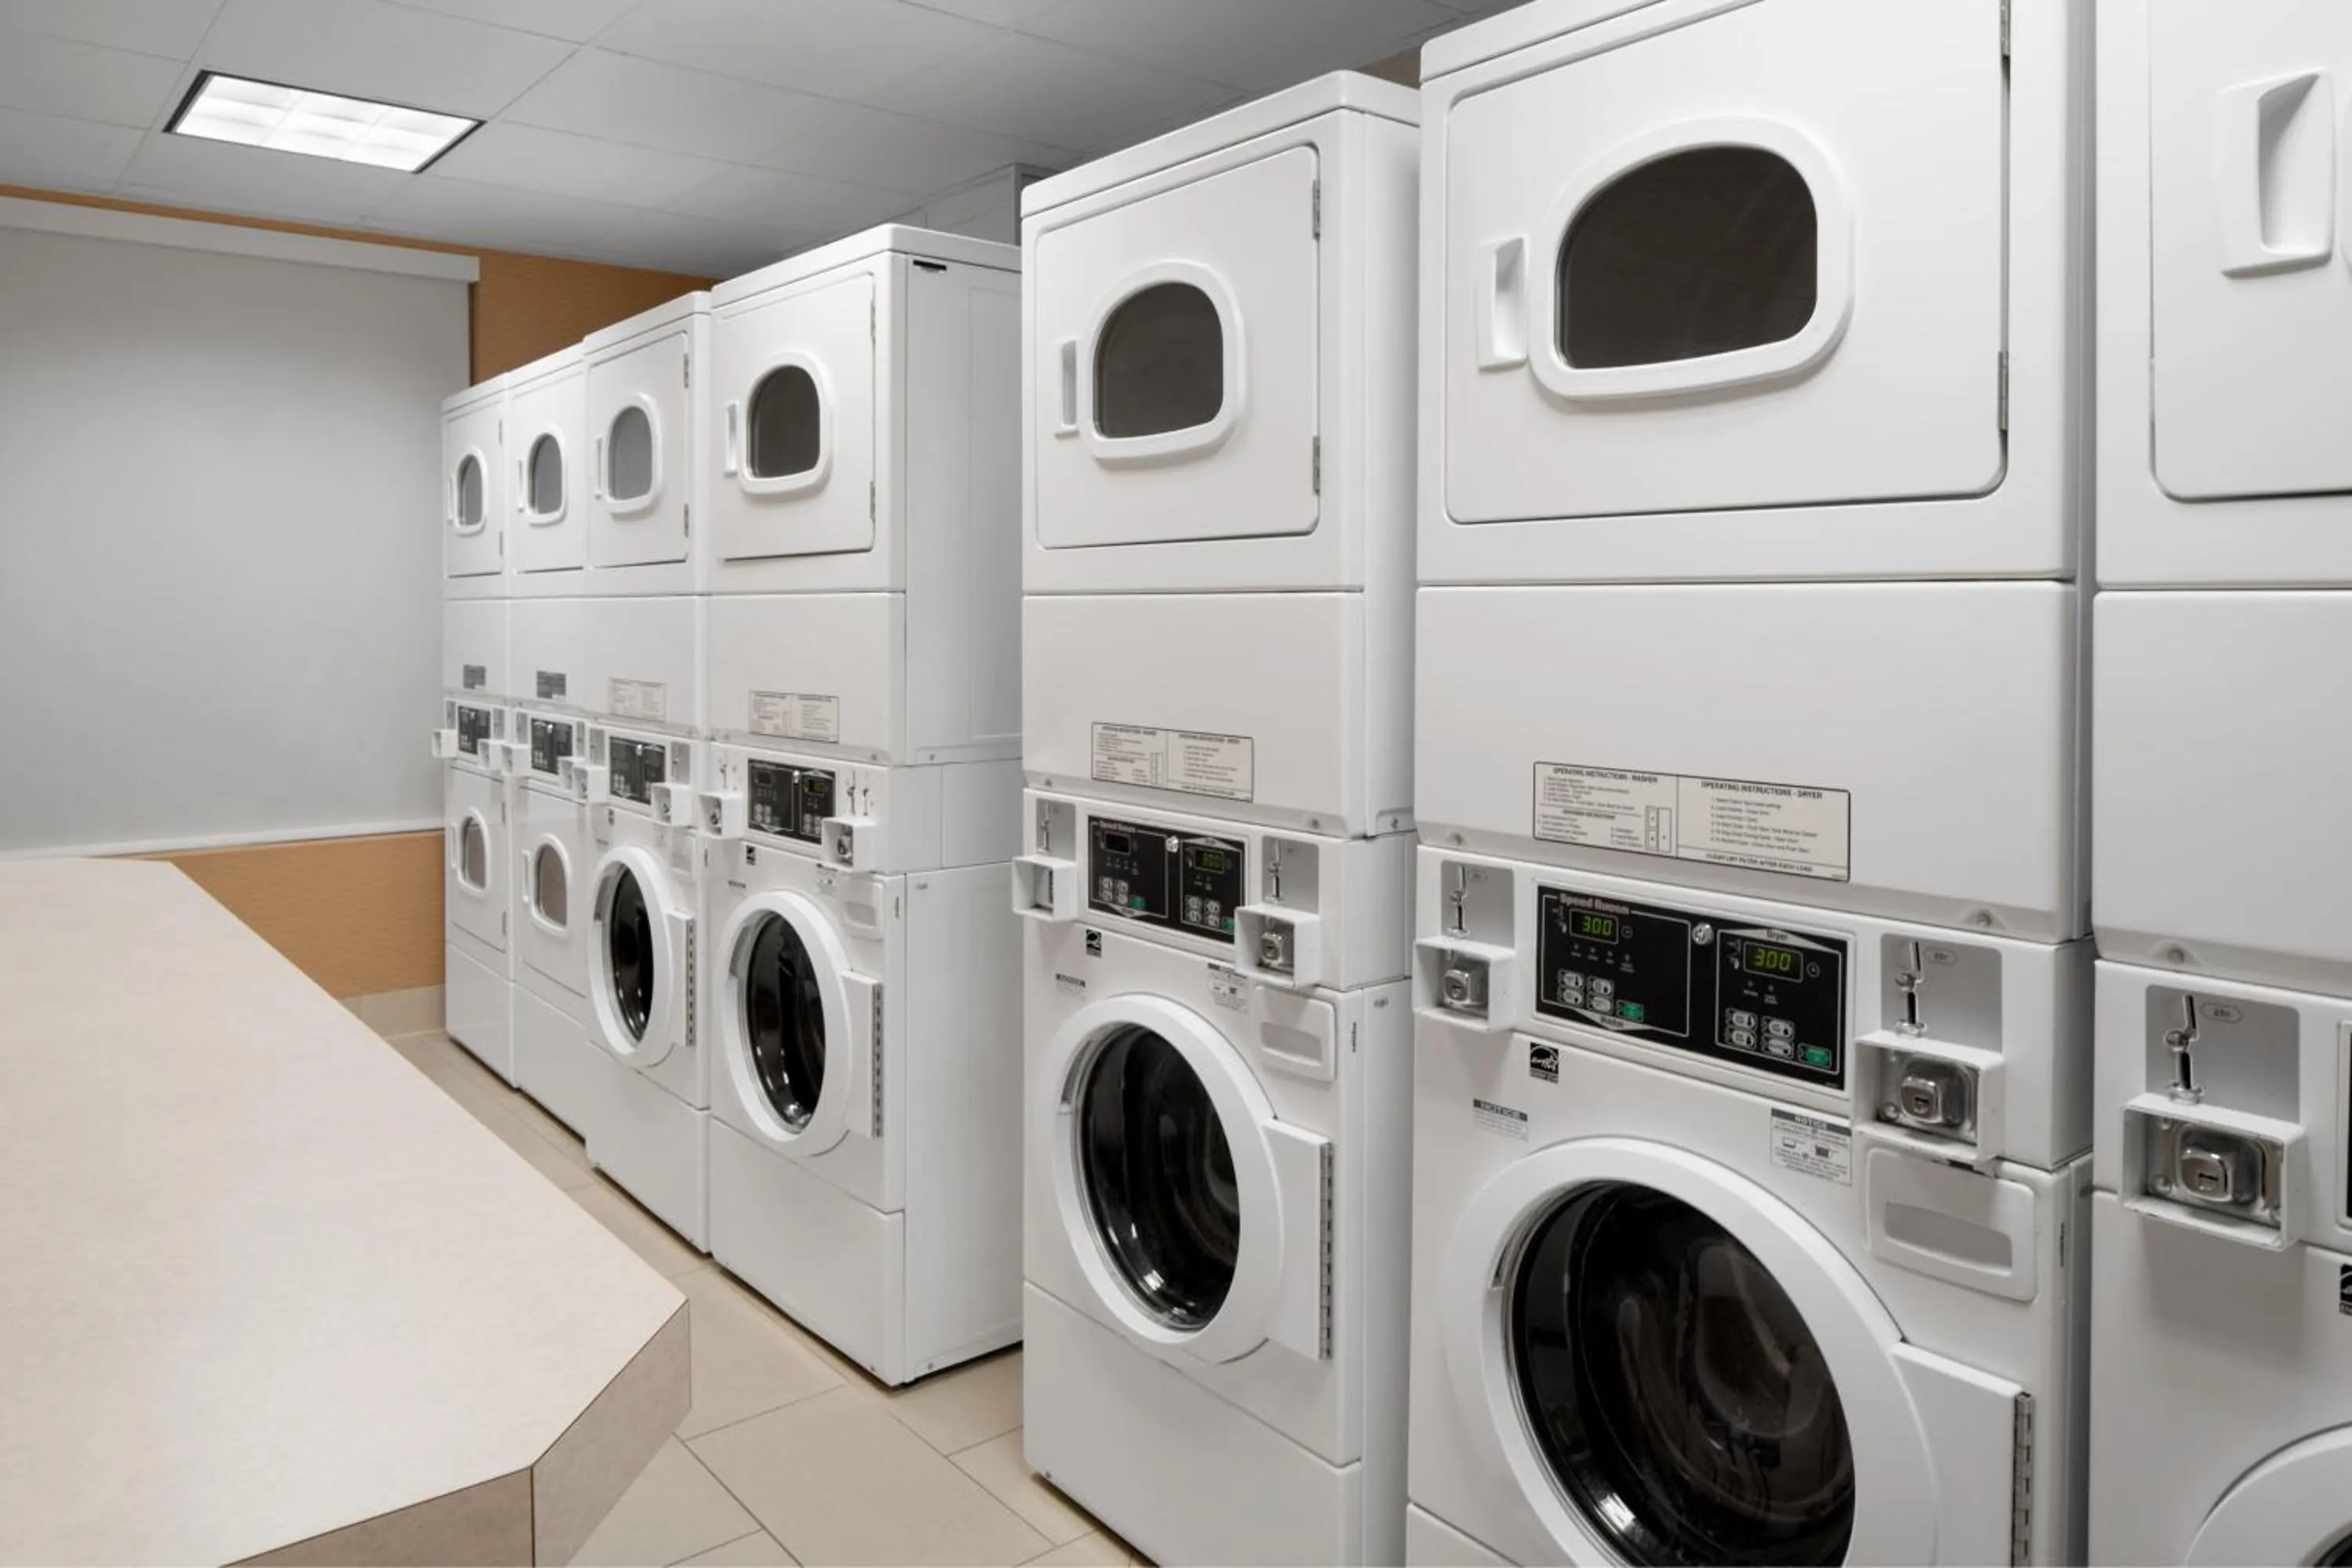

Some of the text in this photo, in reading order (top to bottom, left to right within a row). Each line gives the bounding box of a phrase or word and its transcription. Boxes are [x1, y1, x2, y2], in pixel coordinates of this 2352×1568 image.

[1632, 775, 1658, 784] WASHER
[1701, 781, 1739, 792] OPERATING
[1740, 785, 1791, 797] INSTRUCTIONS
[1797, 791, 1824, 800] DRYER
[1559, 892, 1631, 915] Speed Queen
[1582, 915, 1613, 936] 300
[1766, 929, 1788, 942] Dryer
[1755, 947, 1791, 971] 300
